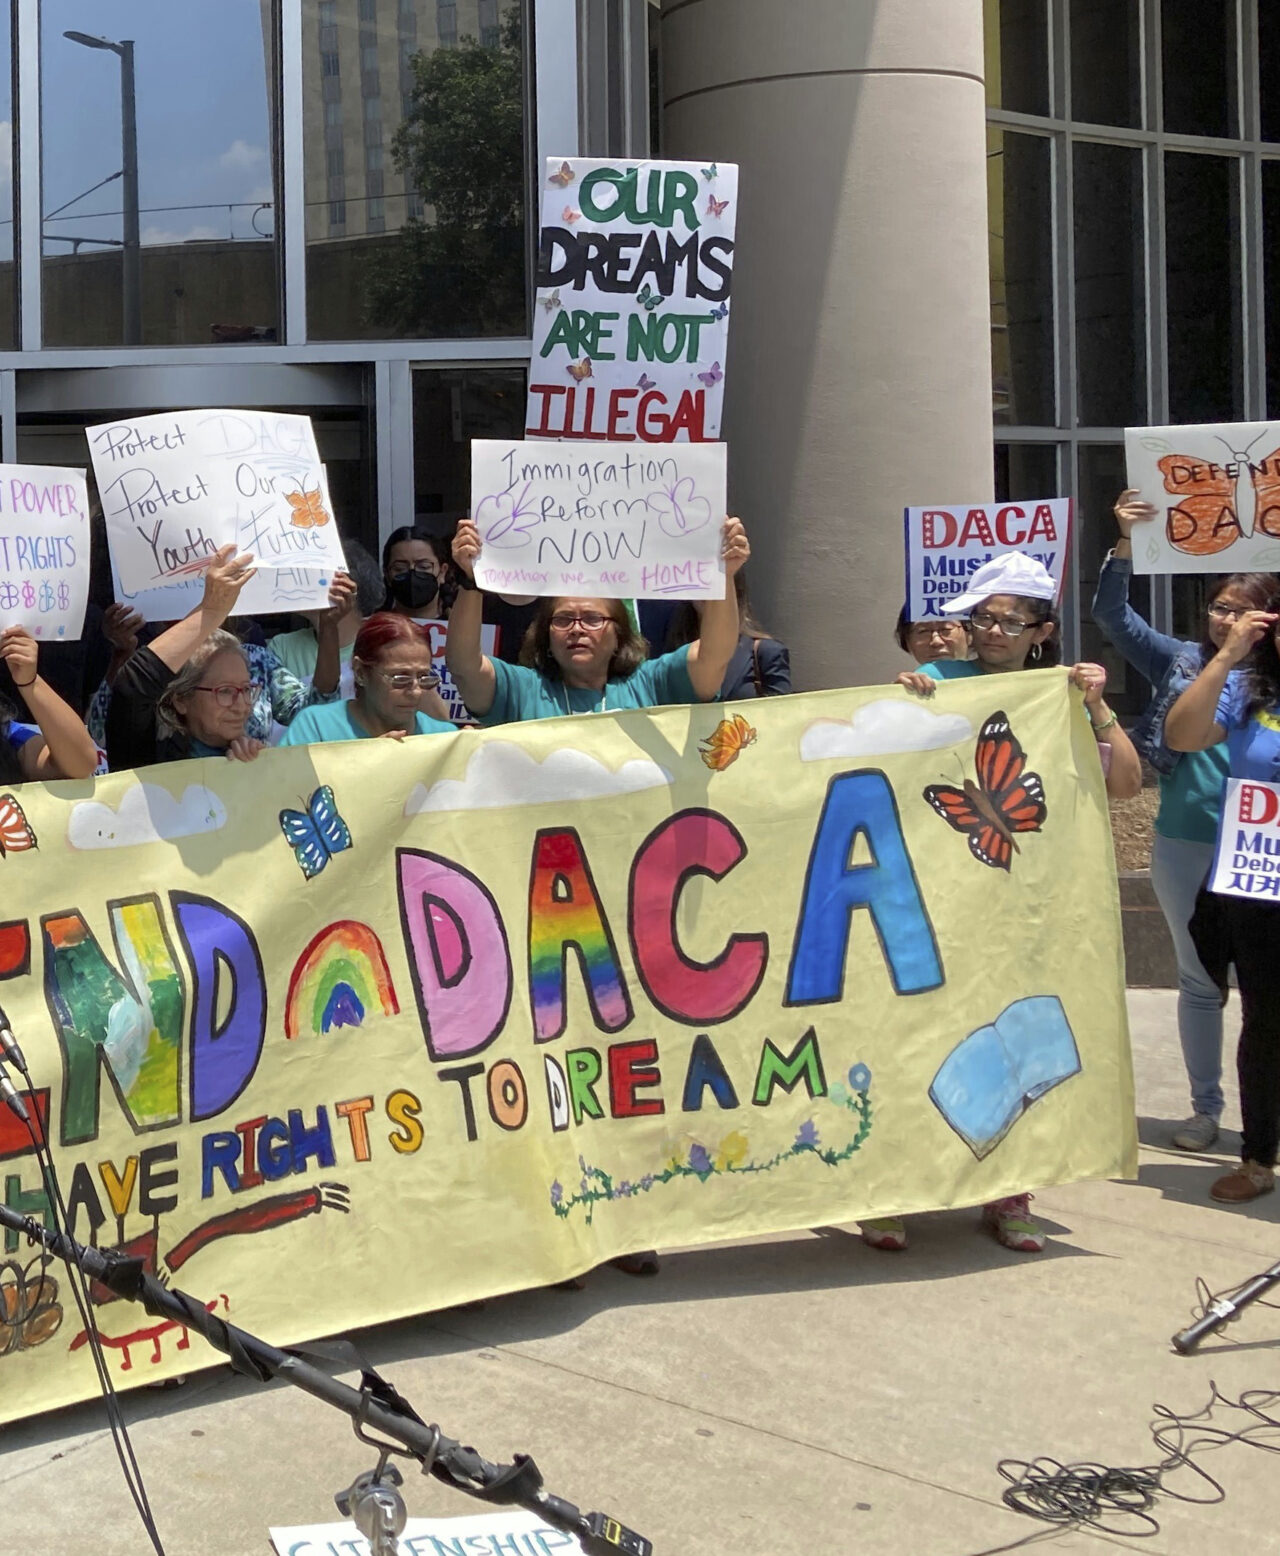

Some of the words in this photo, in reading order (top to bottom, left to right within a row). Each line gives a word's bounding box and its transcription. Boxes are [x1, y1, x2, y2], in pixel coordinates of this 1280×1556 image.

[578, 167, 701, 231] OUR
[535, 227, 735, 301] DREAMS
[540, 309, 619, 361] ARE
[626, 313, 715, 363] NOT
[526, 384, 719, 443] ILLEGAL
[93, 423, 186, 461] Protect
[197, 415, 310, 452] DACA
[105, 468, 208, 522] Protect
[235, 463, 276, 497] Our
[502, 449, 678, 496] Immigration
[1171, 458, 1280, 485] DEFEN
[10, 478, 85, 521] POWER,
[540, 496, 648, 522] Reform
[137, 519, 219, 575] Youth
[241, 502, 328, 559] Future
[538, 520, 646, 564] NOW
[922, 505, 1057, 549] DACA
[1168, 505, 1280, 543] DAC
[16, 535, 77, 572] RIGHTS
[561, 570, 584, 584] we
[600, 571, 629, 585] are
[642, 560, 714, 591] HOME
[1232, 853, 1280, 873] Deb
[395, 767, 946, 1062] DACA
[201, 1087, 425, 1200] RIGHTS
[437, 1057, 528, 1141] TO
[544, 1025, 828, 1133] DREAM
